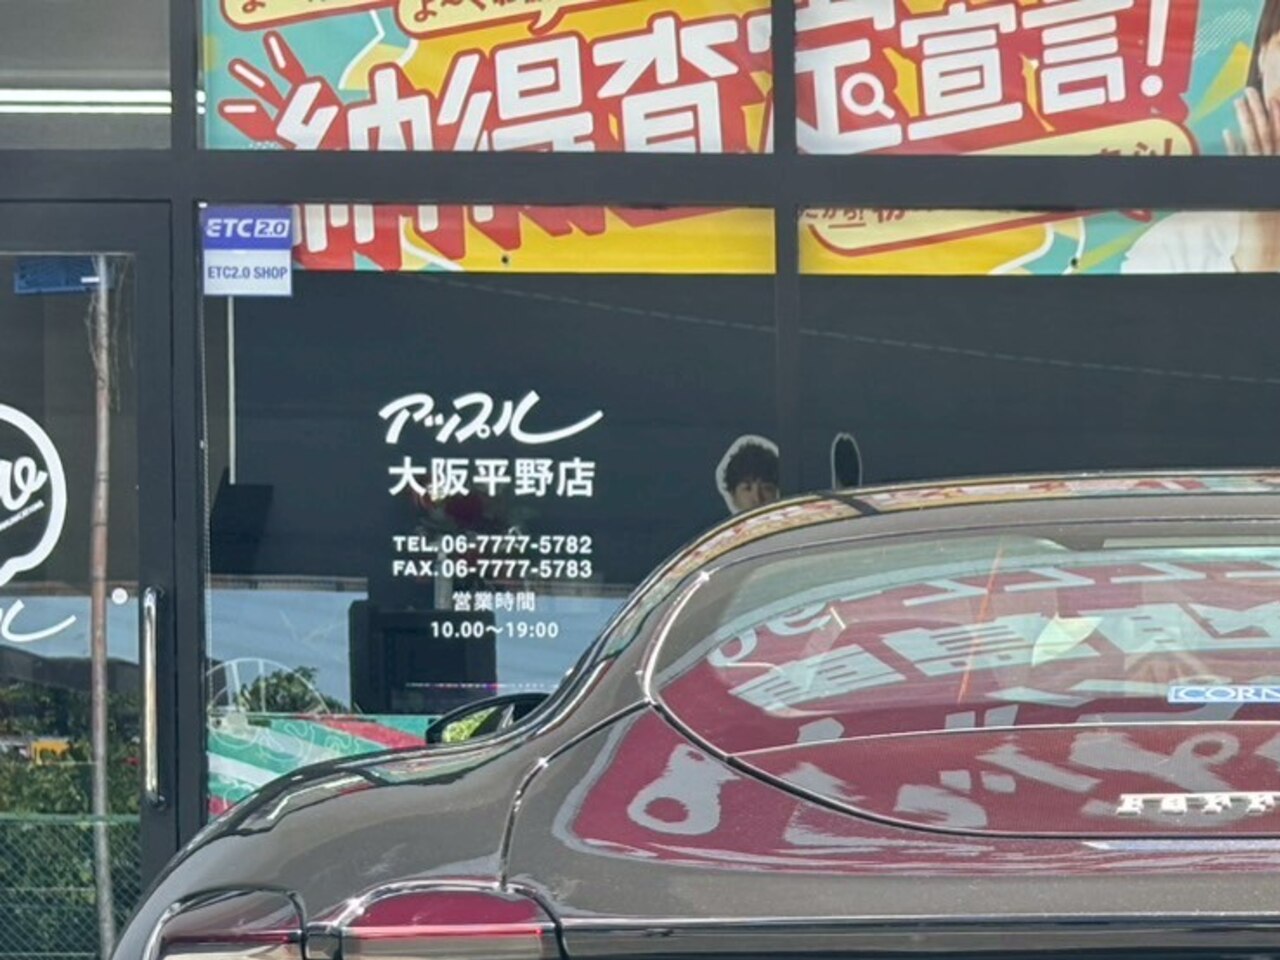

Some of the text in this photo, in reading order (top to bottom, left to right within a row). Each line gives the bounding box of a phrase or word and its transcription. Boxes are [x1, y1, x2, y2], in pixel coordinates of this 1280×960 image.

[207, 266, 289, 280] ETC2.0 SHOP
[378, 390, 604, 444] アップル
[387, 455, 596, 498] 大阪平野店
[452, 591, 536, 613] 営業時間
